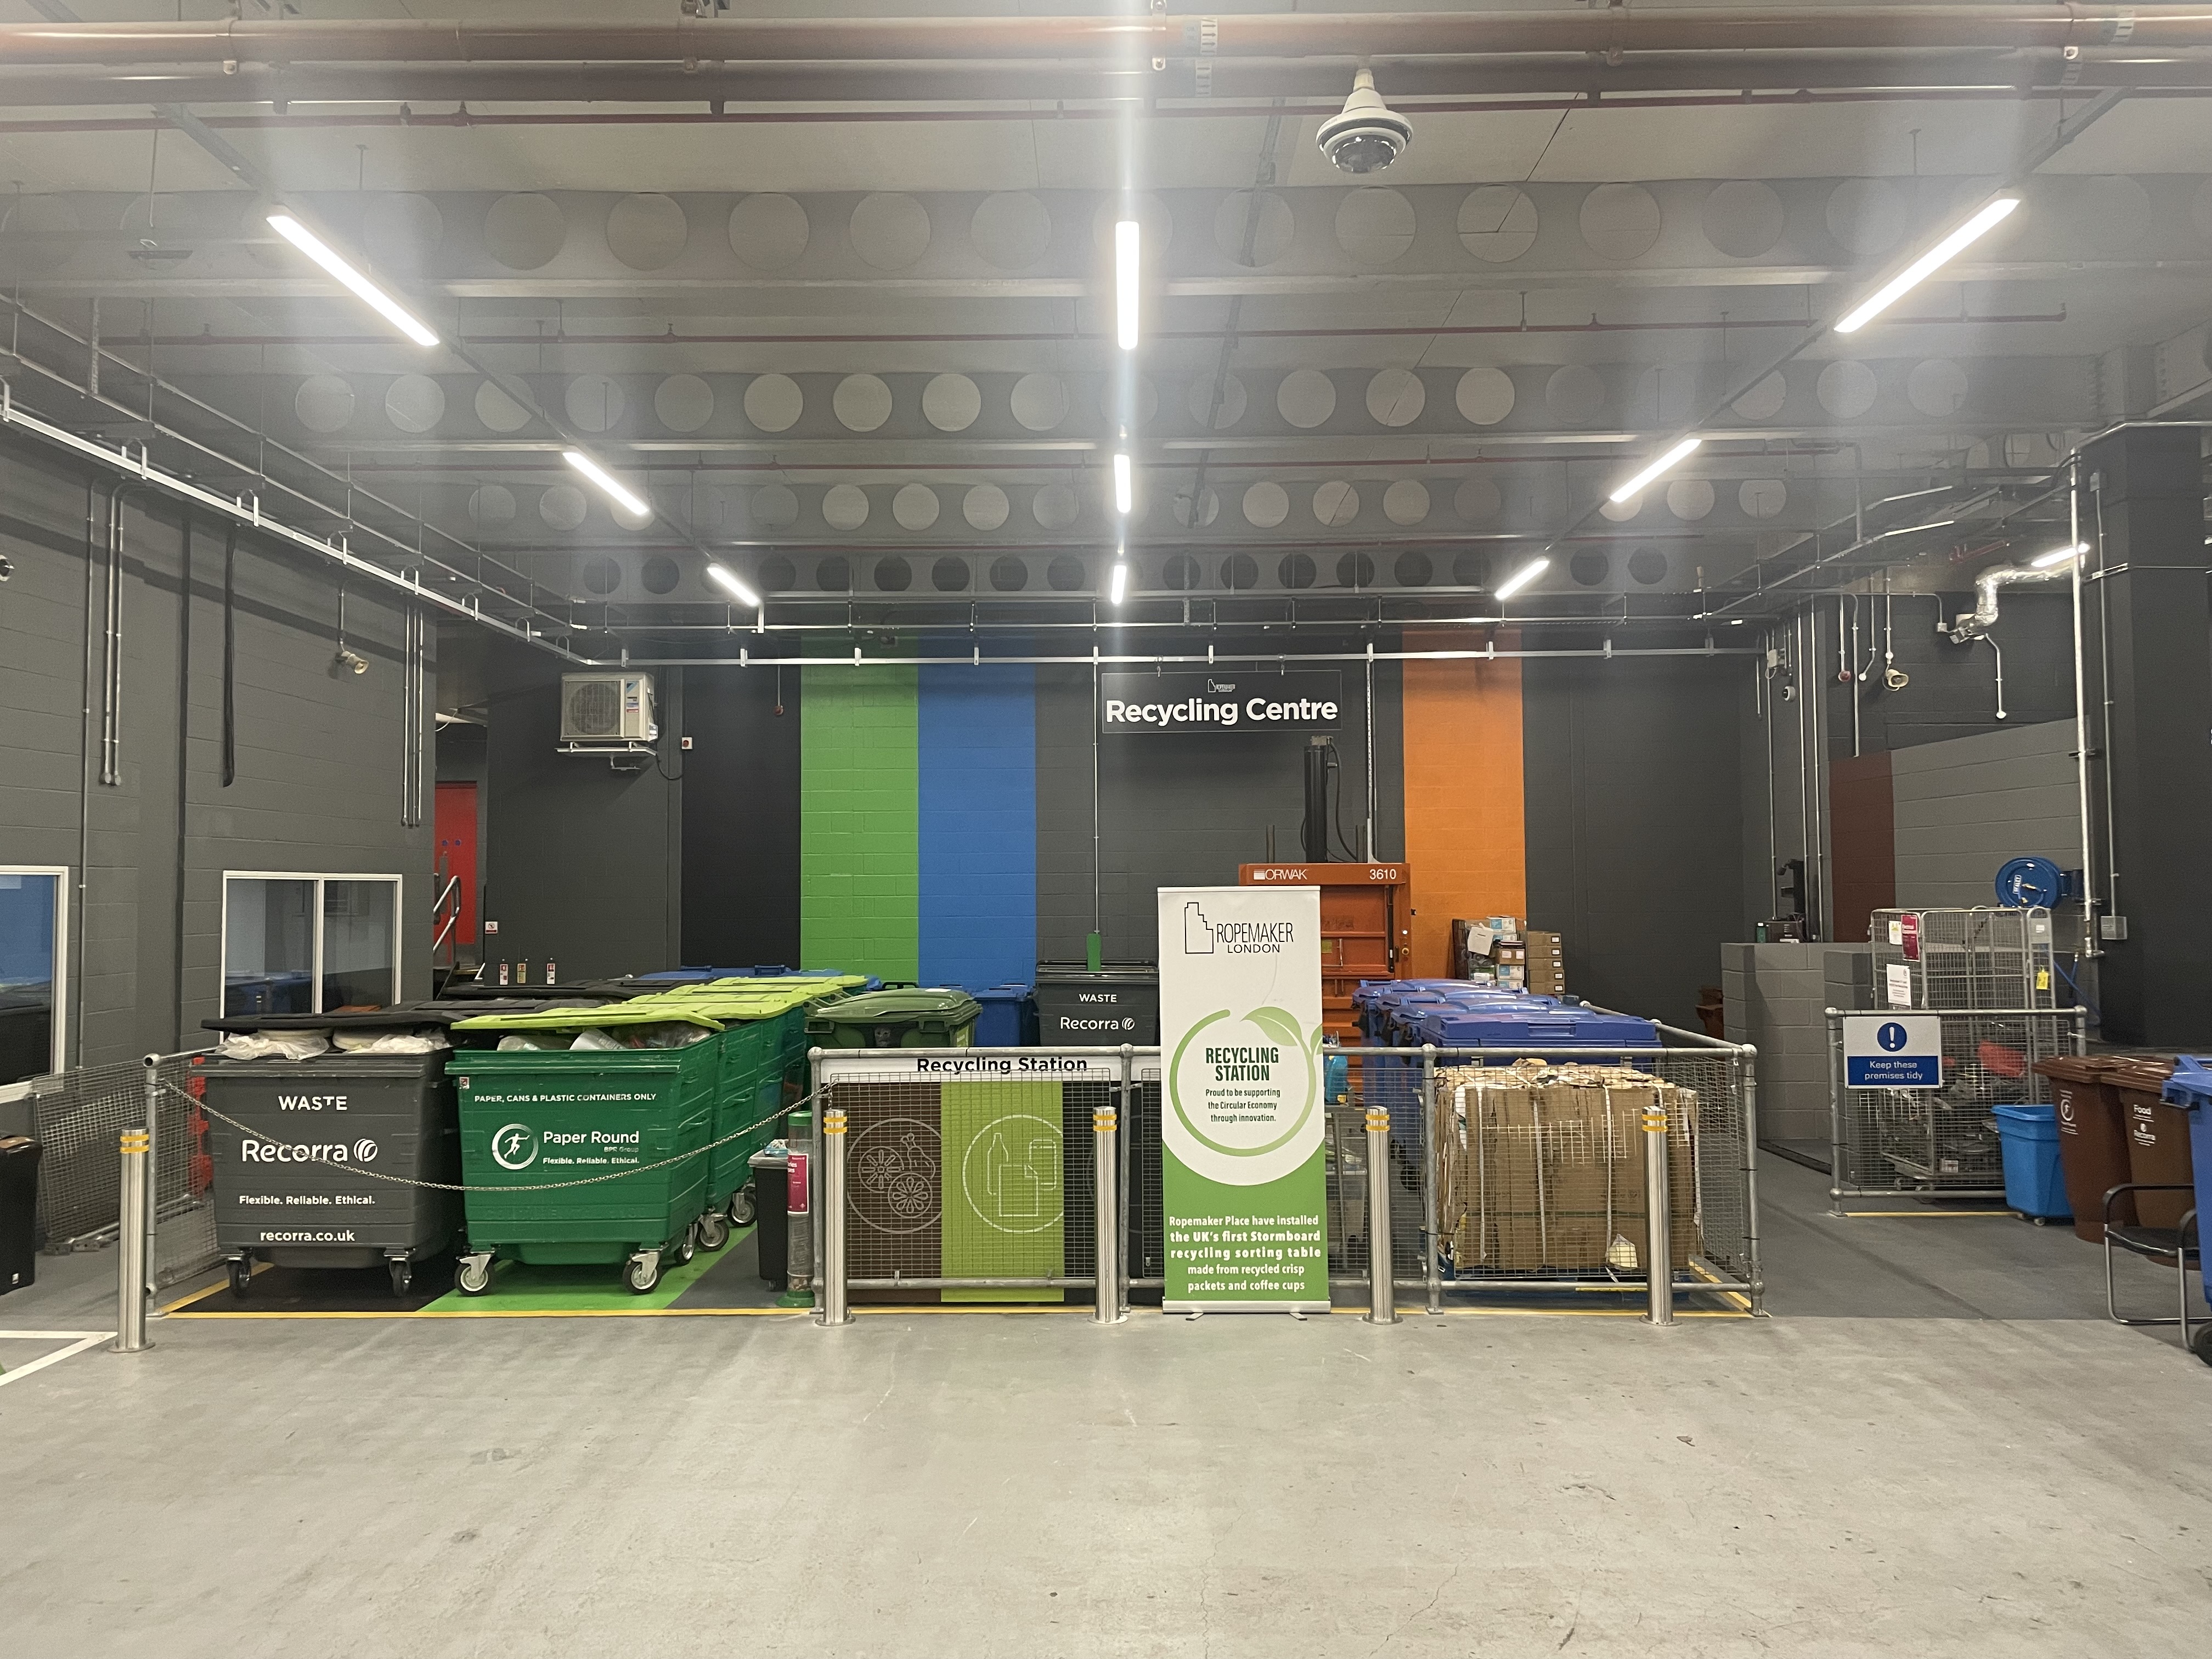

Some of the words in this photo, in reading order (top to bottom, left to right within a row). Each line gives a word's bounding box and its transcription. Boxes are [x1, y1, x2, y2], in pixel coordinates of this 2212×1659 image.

[1106, 698, 1238, 726] Recycling
[1246, 698, 1338, 721] Centre
[1265, 869, 1307, 880] ORWAK
[1369, 869, 1396, 880] 3610
[1217, 922, 1294, 943] ROPEMAKER
[1228, 944, 1280, 953] LONDON
[1079, 994, 1117, 1002] WASTE
[1060, 1017, 1119, 1030] Recorra
[1206, 1047, 1279, 1063] RECYCLING
[917, 1057, 1011, 1075] Recycling
[1019, 1057, 1087, 1071] Station
[1870, 1061, 1891, 1070] Keep
[1216, 1065, 1269, 1081] STATION
[1865, 1071, 1904, 1080] premises
[1906, 1071, 1922, 1080] tidy
[1244, 1088, 1280, 1097] supporting
[278, 1096, 347, 1110] WASTE
[1248, 1102, 1277, 1110] Economy
[2133, 1104, 2152, 1115] Food
[1211, 1114, 1237, 1123] through
[1239, 1114, 1276, 1122] innovation.
[544, 1131, 586, 1146] Paper
[591, 1131, 639, 1143] Round
[242, 1139, 348, 1163] Recorra
[239, 1195, 283, 1205] Flexible.
[286, 1195, 331, 1205] Reliable.
[335, 1195, 375, 1205] Ethical.
[1170, 1216, 1223, 1228] Ropemaker
[1226, 1216, 1249, 1226] Place
[1252, 1216, 1275, 1226] have
[1277, 1215, 1318, 1225] installed
[261, 1230, 354, 1242] recorra.co.uk
[1170, 1231, 1189, 1242] the
[1222, 1231, 1248, 1242] first
[1251, 1230, 1321, 1242] Stormboard
[1171, 1247, 1231, 1261] recycling
[1235, 1246, 1283, 1260] sorting
[1288, 1246, 1321, 1257] table
[1188, 1265, 1214, 1274] made
[1216, 1264, 1239, 1274] from
[1242, 1264, 1279, 1277] recycled
[1282, 1263, 1305, 1276] crisp
[1188, 1280, 1226, 1293] packets
[1228, 1280, 1246, 1290] and
[1250, 1280, 1279, 1290] coffee
[1283, 1280, 1305, 1293] cups
